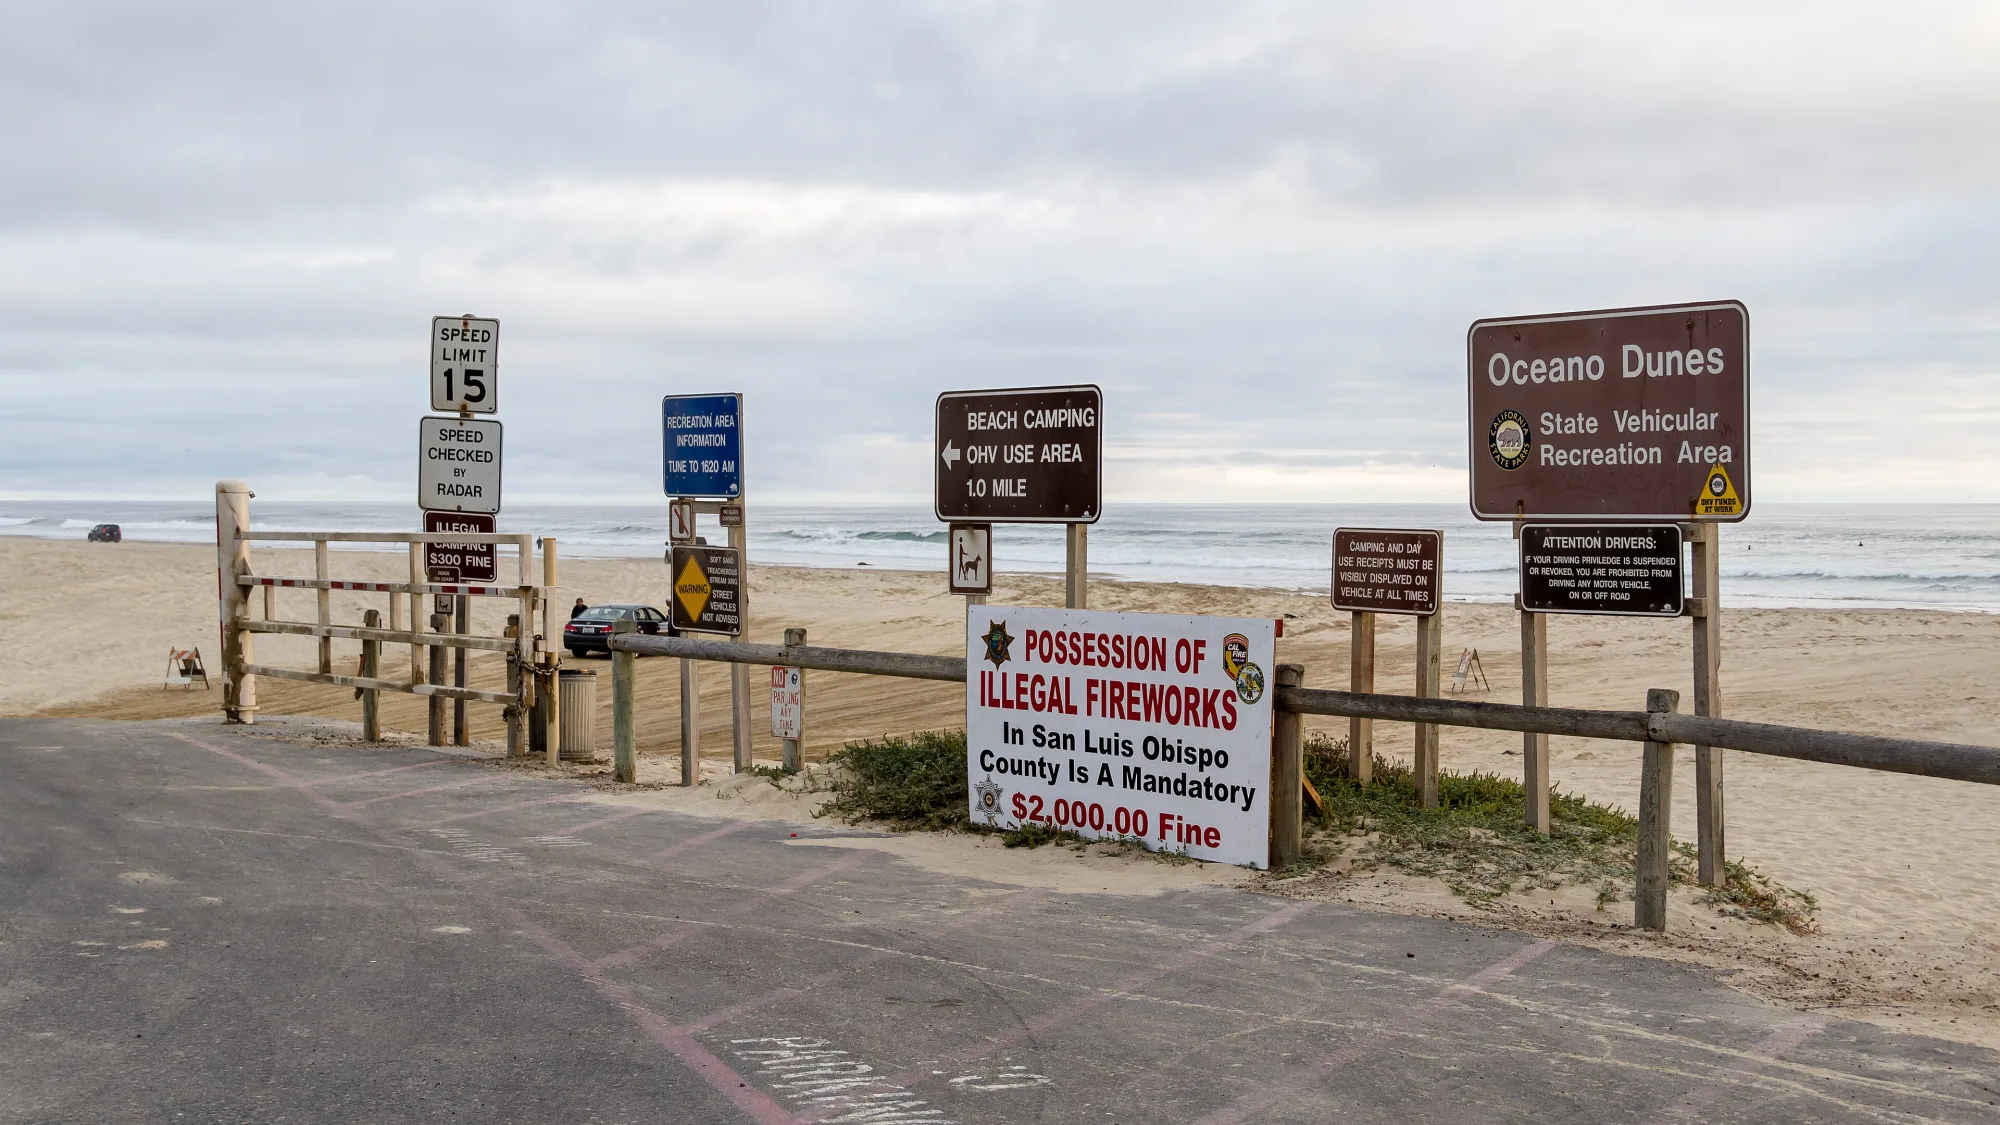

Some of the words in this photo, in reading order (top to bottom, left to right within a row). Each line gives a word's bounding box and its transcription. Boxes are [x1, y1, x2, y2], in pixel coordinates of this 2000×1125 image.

[441, 328, 490, 342] SPEED
[443, 348, 486, 362] LIMIT
[1488, 352, 1604, 386] Oceano
[1622, 344, 1724, 379] Dunes
[444, 368, 486, 403] 15
[668, 415, 712, 428] RECREATION
[715, 415, 735, 427] AREA
[968, 411, 1017, 430] BEACH
[1024, 408, 1095, 429] CAMPING
[1491, 411, 1528, 436] CALIFORNIA
[1540, 412, 1598, 435] State
[1613, 408, 1718, 432] Vehicular
[439, 429, 483, 442] SPEED
[677, 434, 726, 446] INFORMATION
[428, 447, 493, 463] CHECKED
[967, 445, 997, 464] OHV
[1004, 444, 1034, 463] USE
[1040, 444, 1082, 463] AREA
[1490, 443, 1508, 467] STATE
[1512, 443, 1529, 467] PARKS
[1540, 442, 1662, 466] Recreation
[1677, 441, 1732, 464] Area
[454, 468, 466, 477] BY
[668, 460, 686, 472] TUNE
[689, 460, 698, 472] TO
[701, 460, 719, 472] 1620
[722, 460, 734, 472] AM
[437, 483, 482, 497] RADAR
[967, 479, 986, 497] 1.0
[992, 479, 1027, 497] MILE
[1350, 541, 1385, 553] CAMPING
[1387, 543, 1404, 553] AND
[1407, 544, 1422, 554] DAY
[1543, 537, 1600, 548] ATTENTION
[1606, 537, 1657, 549] DRIVERS:
[430, 553, 461, 565] $300
[466, 556, 491, 567] FINE
[1339, 556, 1354, 567] USE
[1357, 557, 1394, 568] RECEIPTS
[1397, 559, 1419, 570] MUST
[1422, 560, 1433, 570] BE
[1533, 556, 1551, 564] YOUR
[1553, 556, 1580, 564] DRIVING
[1582, 556, 1621, 565] PRIVILEDGE
[1624, 557, 1630, 565] IS
[1633, 557, 1676, 565] SUSPENDED
[707, 567, 737, 576] TREACHEROUS
[1530, 567, 1539, 575] OR
[1542, 567, 1574, 577] REVOKED,
[1576, 568, 1591, 576] YOU
[1592, 568, 1606, 576] ARE
[1609, 568, 1649, 577] PROHIBITED
[1652, 569, 1672, 577] FROM
[1340, 572, 1367, 582] VISIBLY
[1370, 573, 1412, 585] DISPLAYED
[1415, 575, 1427, 586] ON
[1549, 579, 1575, 588] DRIVING
[1578, 580, 1591, 588] ANY
[1593, 580, 1618, 588] MOTOR
[1620, 580, 1651, 590] VEHICLE,
[678, 584, 708, 595] WARNING
[712, 590, 733, 600] STREET
[1341, 586, 1372, 598] VEHICLE
[1375, 589, 1384, 598] AT
[1387, 590, 1401, 600] ALL
[1404, 590, 1429, 602] TIMES
[1569, 591, 1580, 599] ON
[1582, 592, 1592, 600] OR
[1594, 592, 1608, 600] OFF
[1610, 592, 1630, 600] ROAD
[710, 602, 736, 612] VEHICLES
[703, 613, 714, 621] NOT
[716, 614, 738, 624] ADVISED
[1025, 629, 1167, 671] POSSESSION
[1175, 638, 1206, 674] OF
[774, 669, 783, 685] NO
[774, 691, 798, 705] PARING
[980, 670, 1078, 715] ILLEGAL
[1086, 678, 1238, 731] FIREWORKS
[1003, 722, 1024, 745] In
[1032, 724, 1075, 751] San
[1084, 729, 1133, 757] Luis
[1142, 736, 1229, 772] Obispo
[980, 750, 1060, 786] County
[1069, 758, 1089, 784] Is
[1097, 763, 1114, 787] A
[1122, 766, 1256, 812] Mandatory
[1012, 792, 1148, 837] $2,000.00
[1159, 812, 1221, 848] Fine
